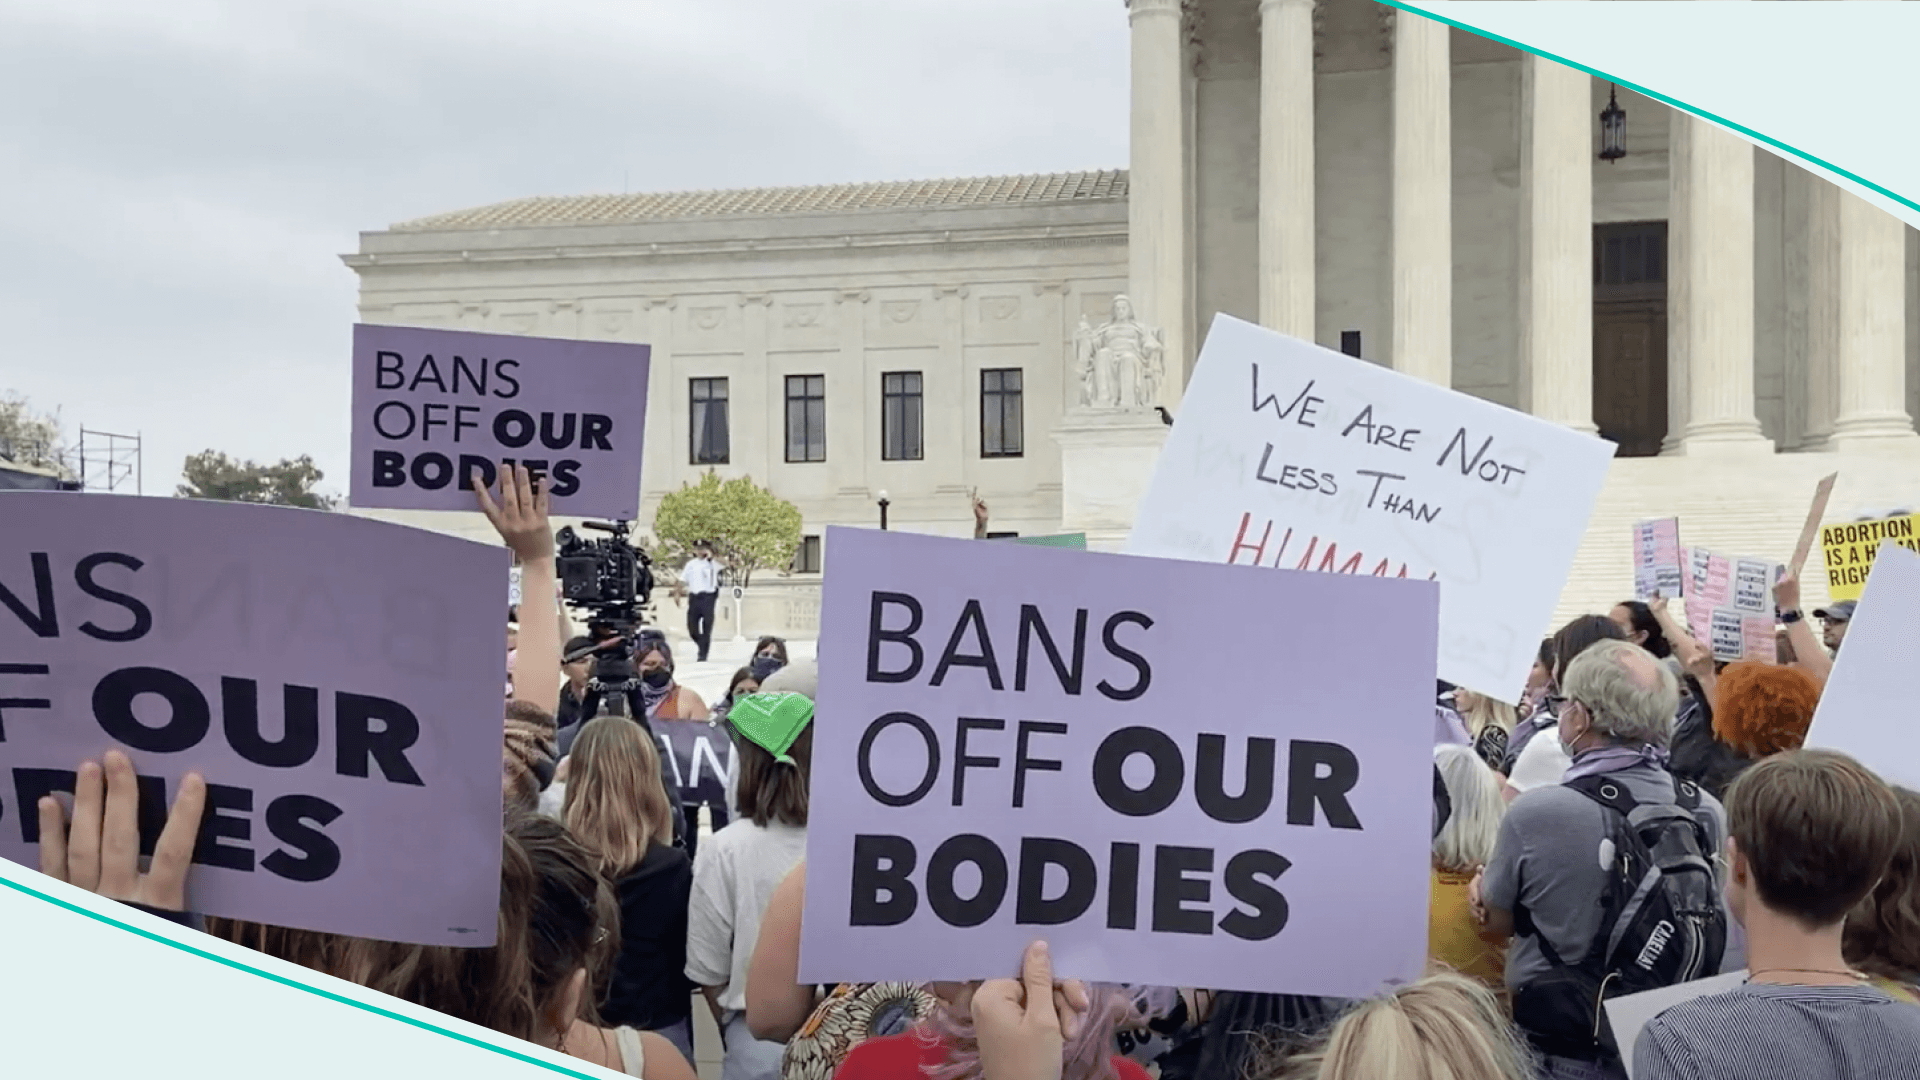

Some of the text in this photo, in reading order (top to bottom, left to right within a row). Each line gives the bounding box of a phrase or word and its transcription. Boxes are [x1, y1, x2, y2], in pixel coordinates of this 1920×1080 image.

[376, 350, 520, 399] BANS
[373, 400, 613, 451] OFF OUR
[1251, 362, 1526, 485] WE ARE NOT
[1256, 442, 1338, 496] LESS
[1355, 469, 1442, 524] THAN
[1228, 512, 1437, 581] HUM
[1823, 519, 1913, 546] ABORTION
[1826, 548, 1843, 566] IS
[1849, 546, 1860, 564] A
[866, 590, 1155, 702] BANS
[91, 666, 426, 787] OUR
[857, 711, 1364, 831] OFF OUR
[0, 766, 344, 883] DIES
[848, 833, 1293, 942] BODIES
